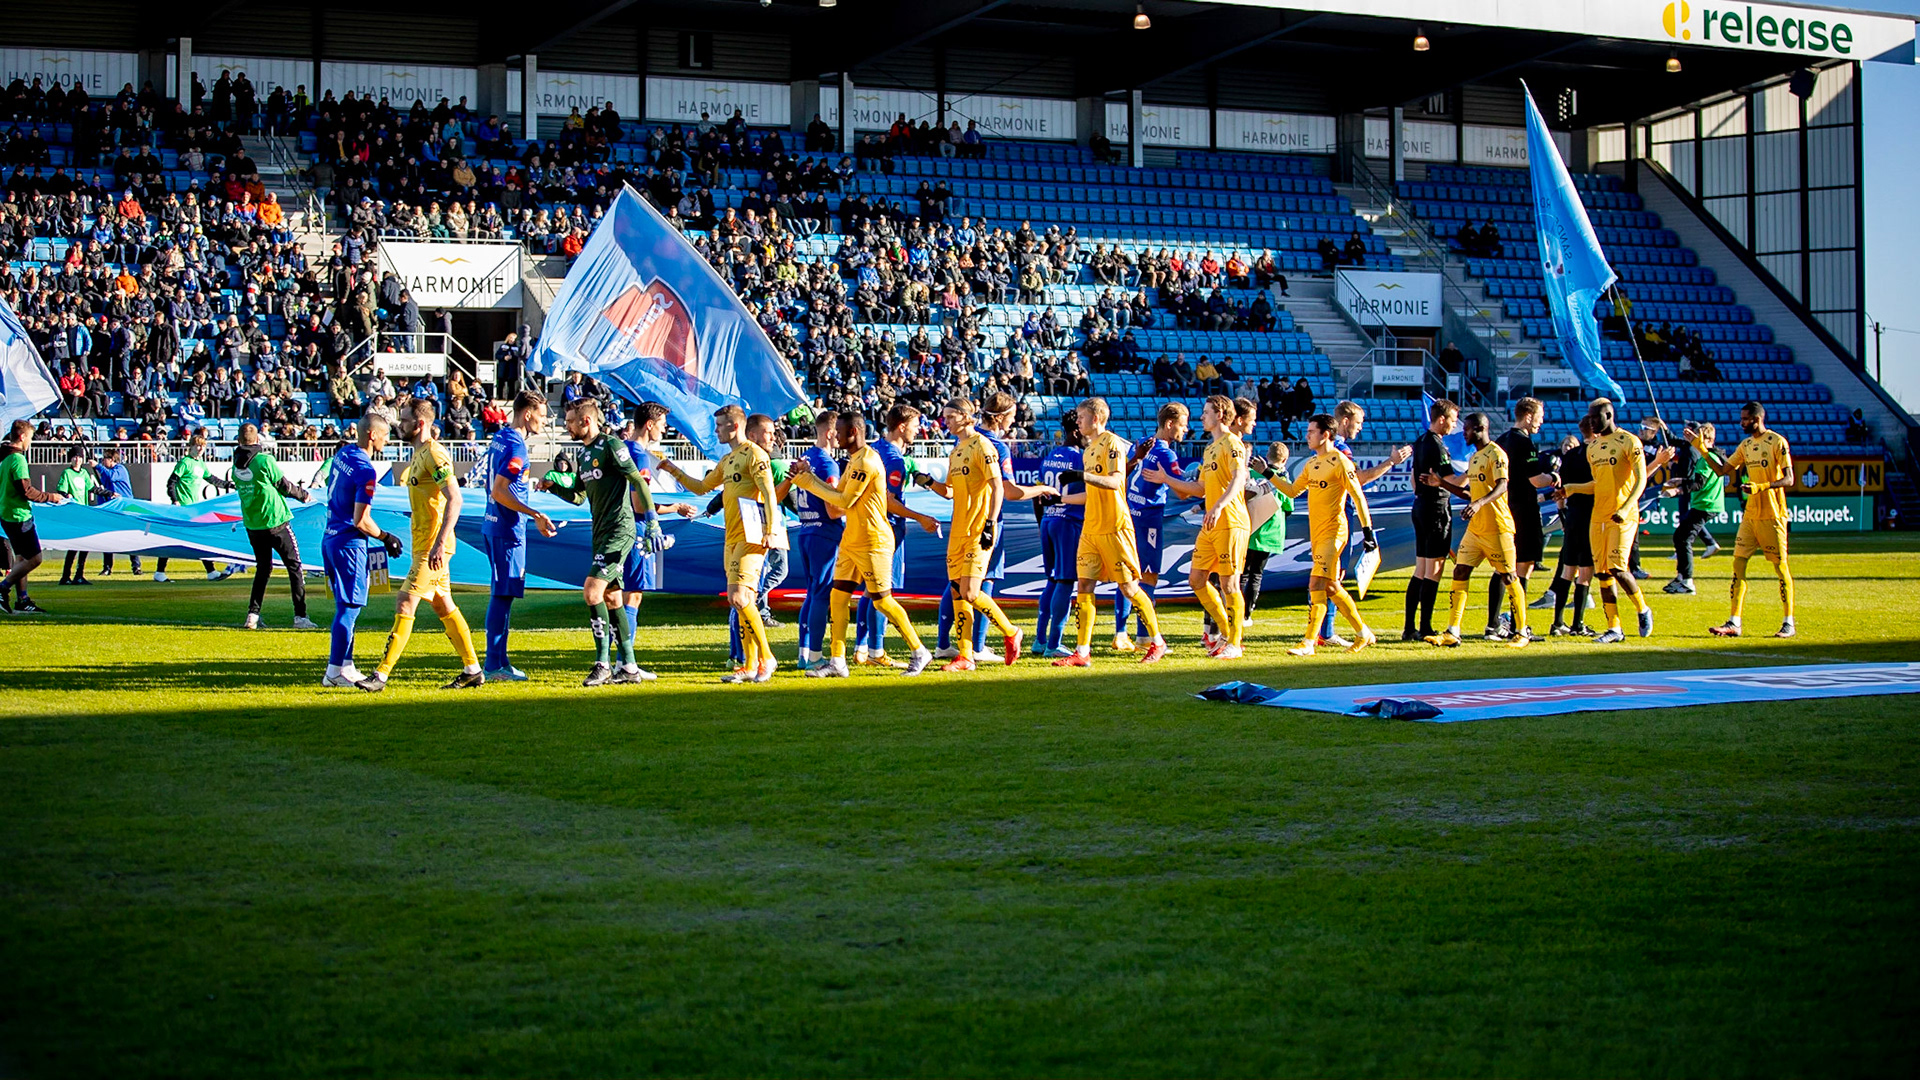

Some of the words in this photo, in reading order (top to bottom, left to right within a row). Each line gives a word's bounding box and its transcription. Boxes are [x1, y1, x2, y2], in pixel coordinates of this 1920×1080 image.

[1703, 6, 1853, 54] release
[690, 35, 702, 68] L
[356, 86, 443, 102] HARMONIE
[536, 93, 605, 110] ARMONIE
[678, 100, 759, 118] HARMONIE
[1428, 92, 1444, 114] M
[974, 116, 1047, 132] HARMONIE
[1111, 123, 1181, 140] HAMONIE
[1242, 131, 1309, 147] HARMONIE
[1367, 138, 1431, 154] HARONIE
[1486, 145, 1527, 160] HARMO
[1349, 299, 1428, 315] HARMONIE
[388, 364, 432, 372] HARMONIE
[1382, 374, 1415, 382] HARMONIE
[1541, 377, 1571, 385] HARMONIE
[1043, 460, 1073, 470] HARMONIE
[1821, 464, 1881, 487] JOTUN
